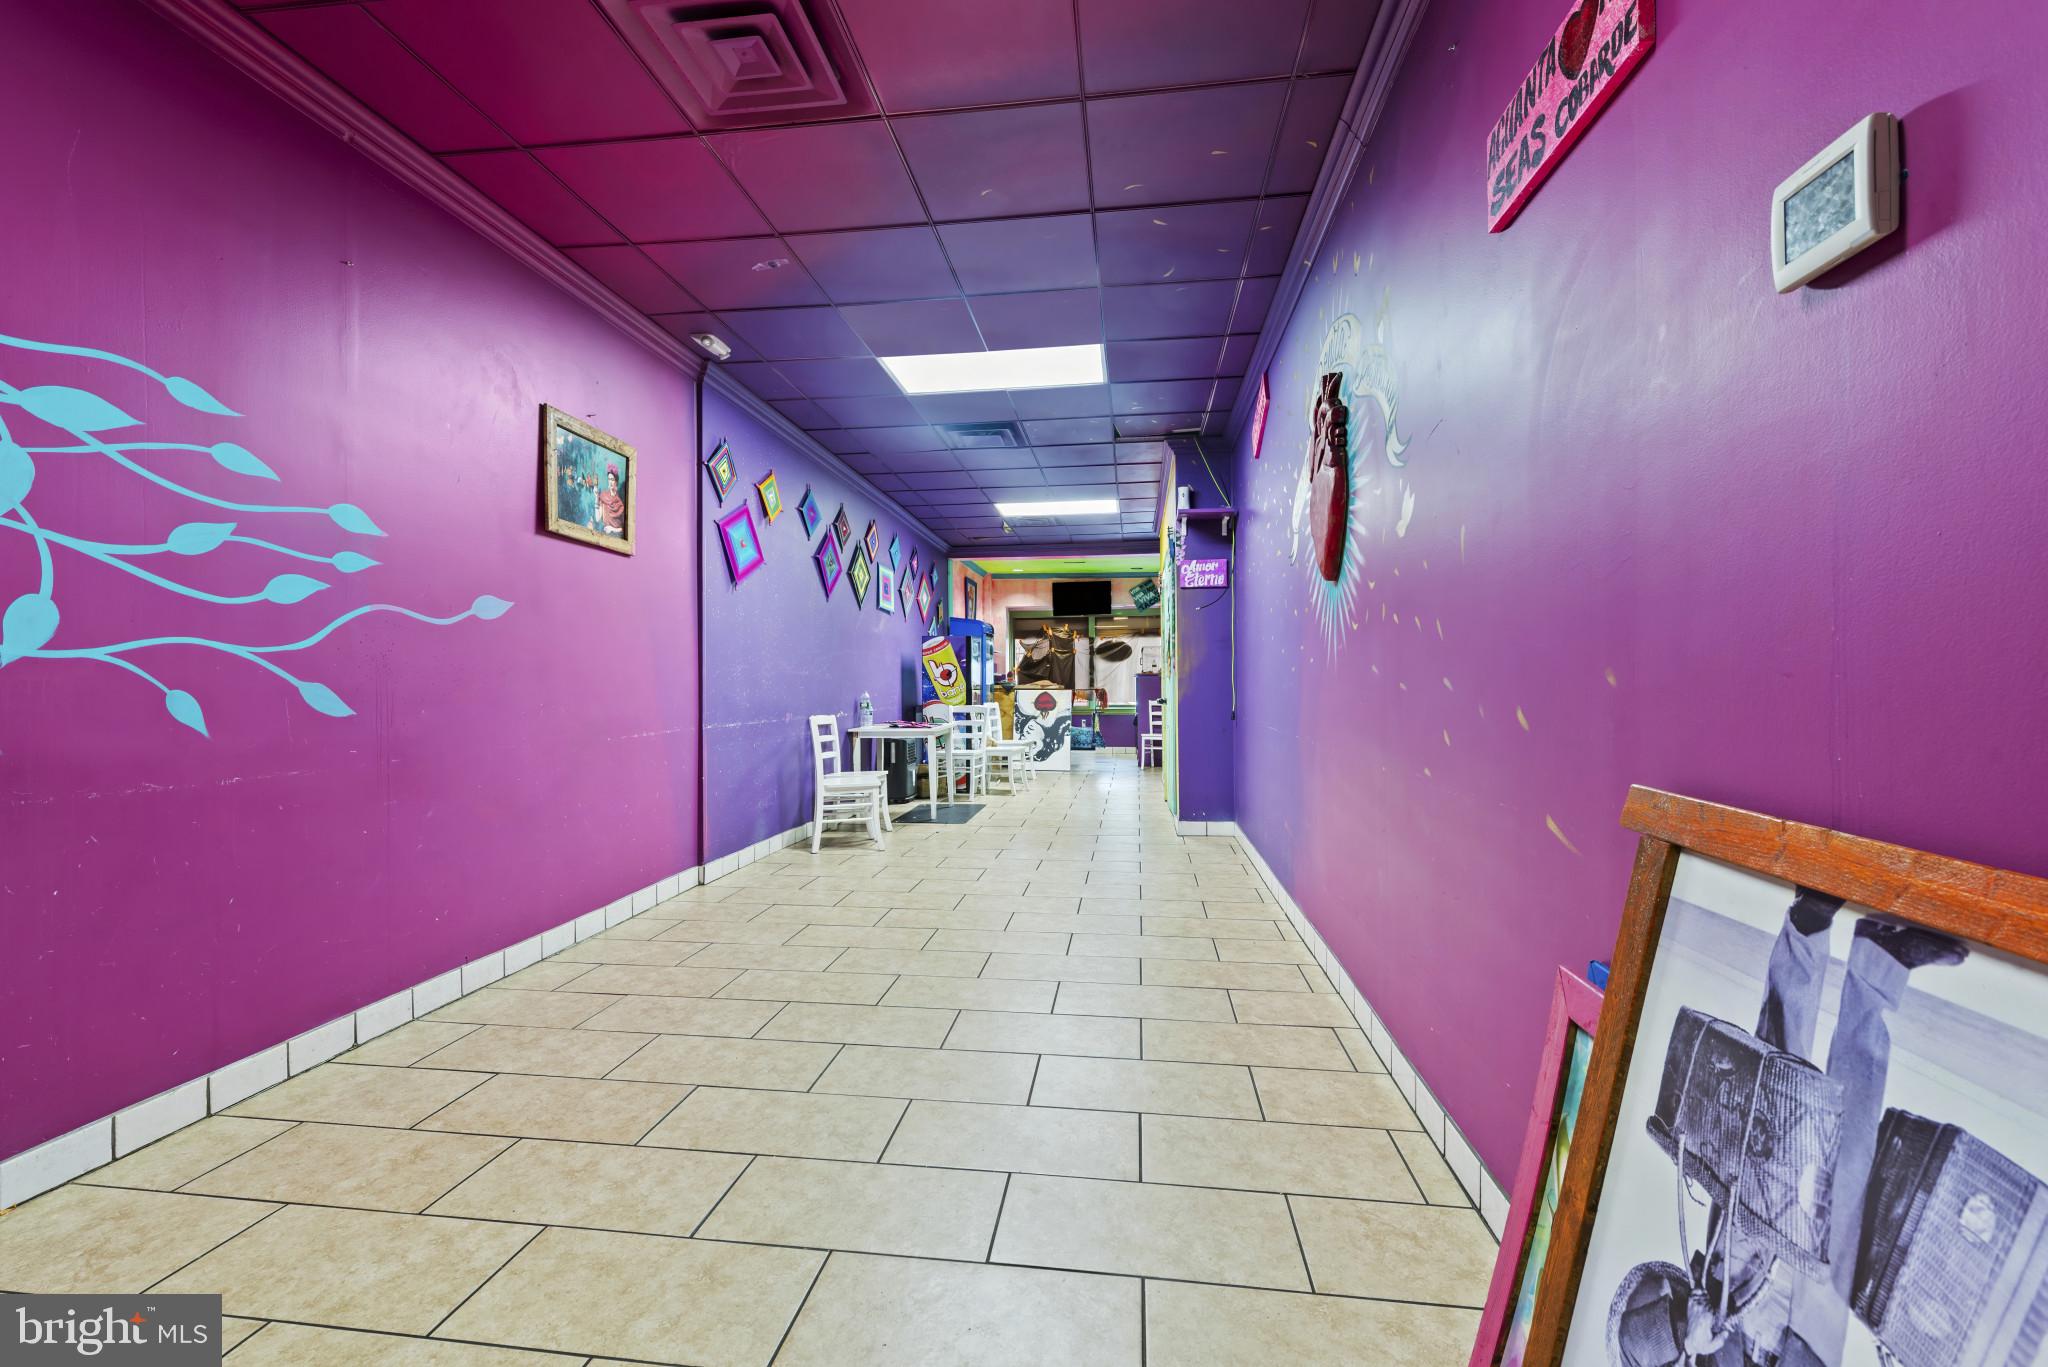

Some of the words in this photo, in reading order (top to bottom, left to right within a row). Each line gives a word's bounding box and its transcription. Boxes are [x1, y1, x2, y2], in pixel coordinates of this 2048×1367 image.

[1490, 113, 1546, 217] SEAS
[1554, 0, 1638, 138] COBARDE
[1181, 560, 1219, 574] Amor
[1184, 571, 1225, 588] Eterno
